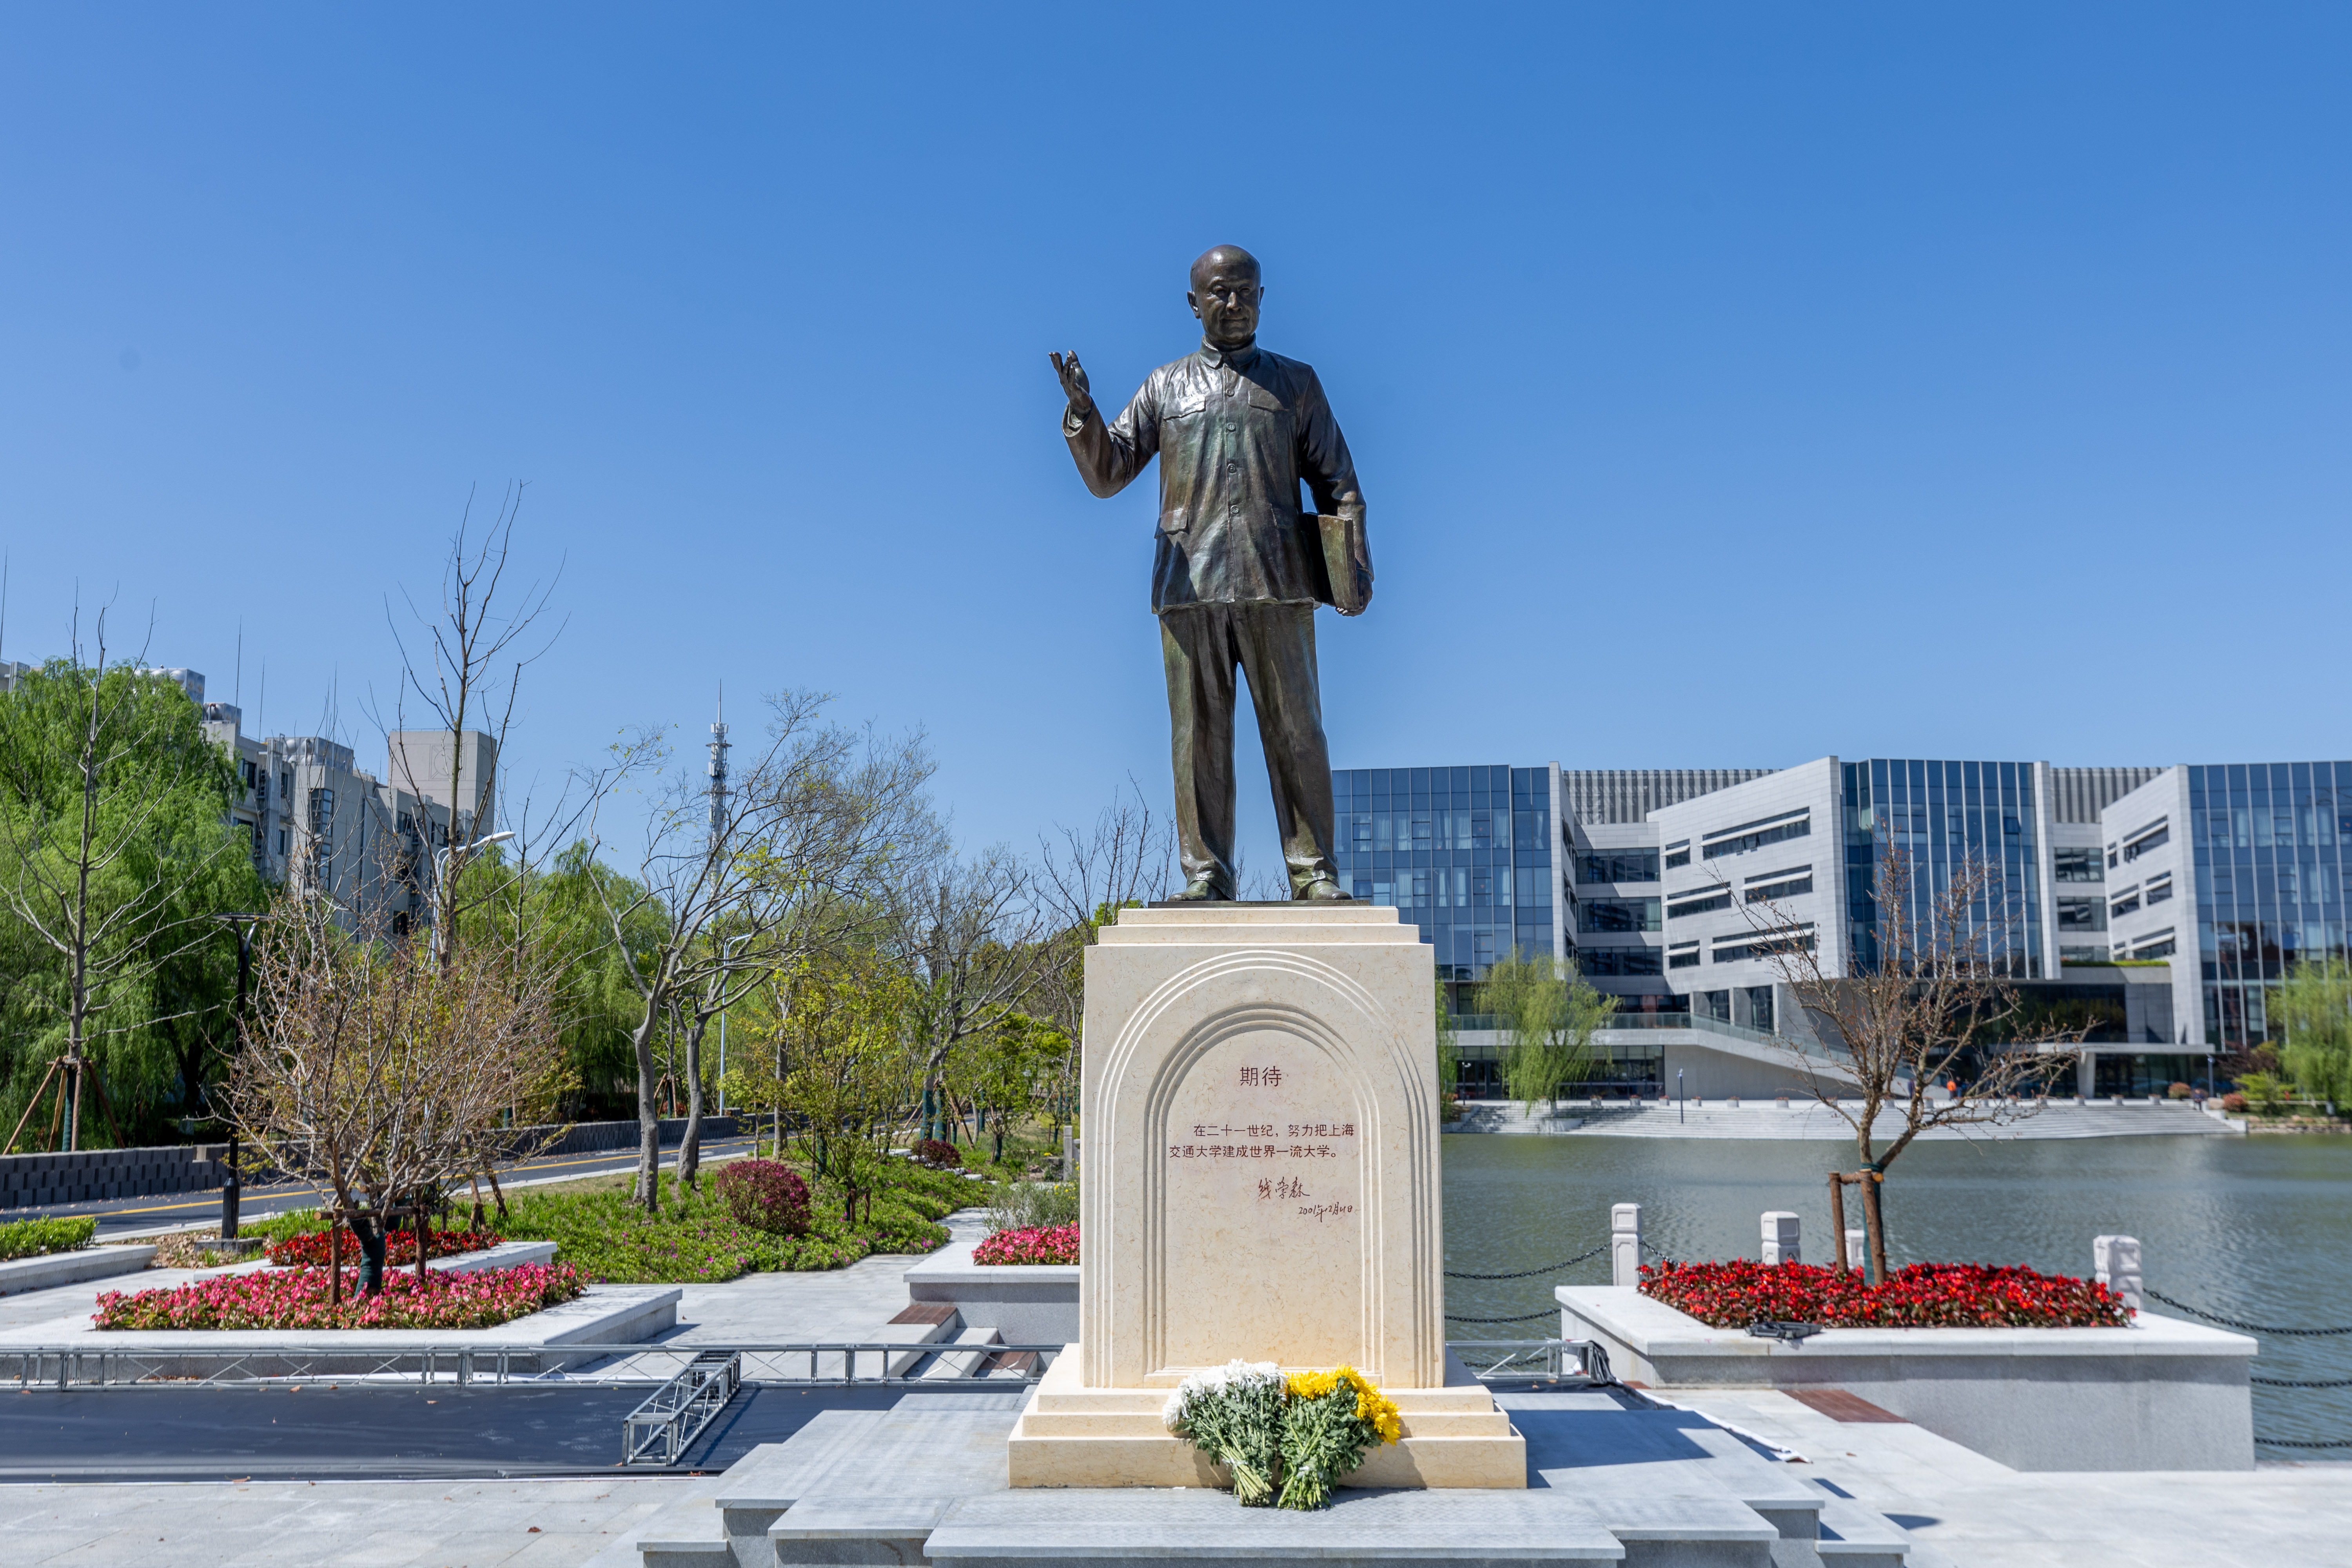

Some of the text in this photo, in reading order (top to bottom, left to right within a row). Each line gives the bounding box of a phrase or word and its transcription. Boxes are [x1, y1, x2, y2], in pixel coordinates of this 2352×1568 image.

[1240, 1065, 1282, 1087] 期待
[1194, 1123, 1354, 1137] 在二十一世纪，努力把上海
[1169, 1145, 1337, 1158] 交通大学建成世界一流大学。
[1258, 1176, 1310, 1199] 钱学森
